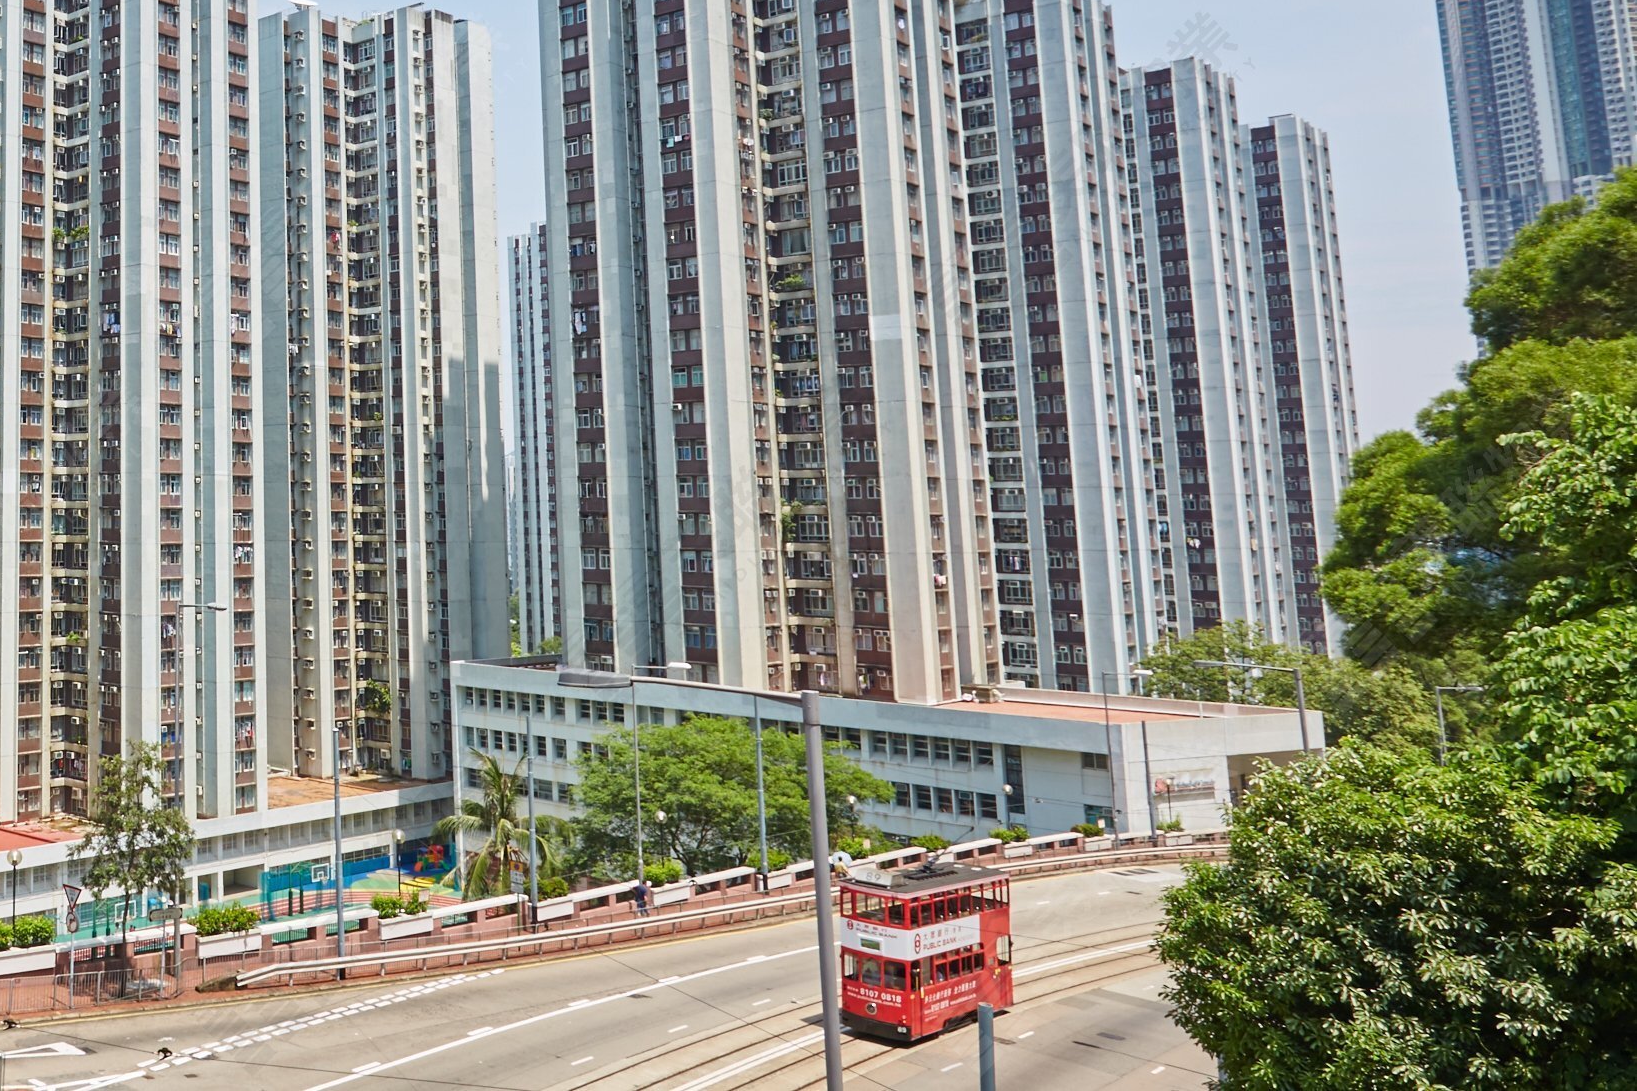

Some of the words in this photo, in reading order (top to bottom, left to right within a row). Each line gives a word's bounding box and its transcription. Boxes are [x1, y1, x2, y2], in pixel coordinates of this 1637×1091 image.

[866, 872, 881, 881] 89
[923, 940, 941, 950] PUBLIC
[943, 937, 957, 946] BANK
[859, 988, 879, 998] 8107
[881, 992, 901, 1003] 0818
